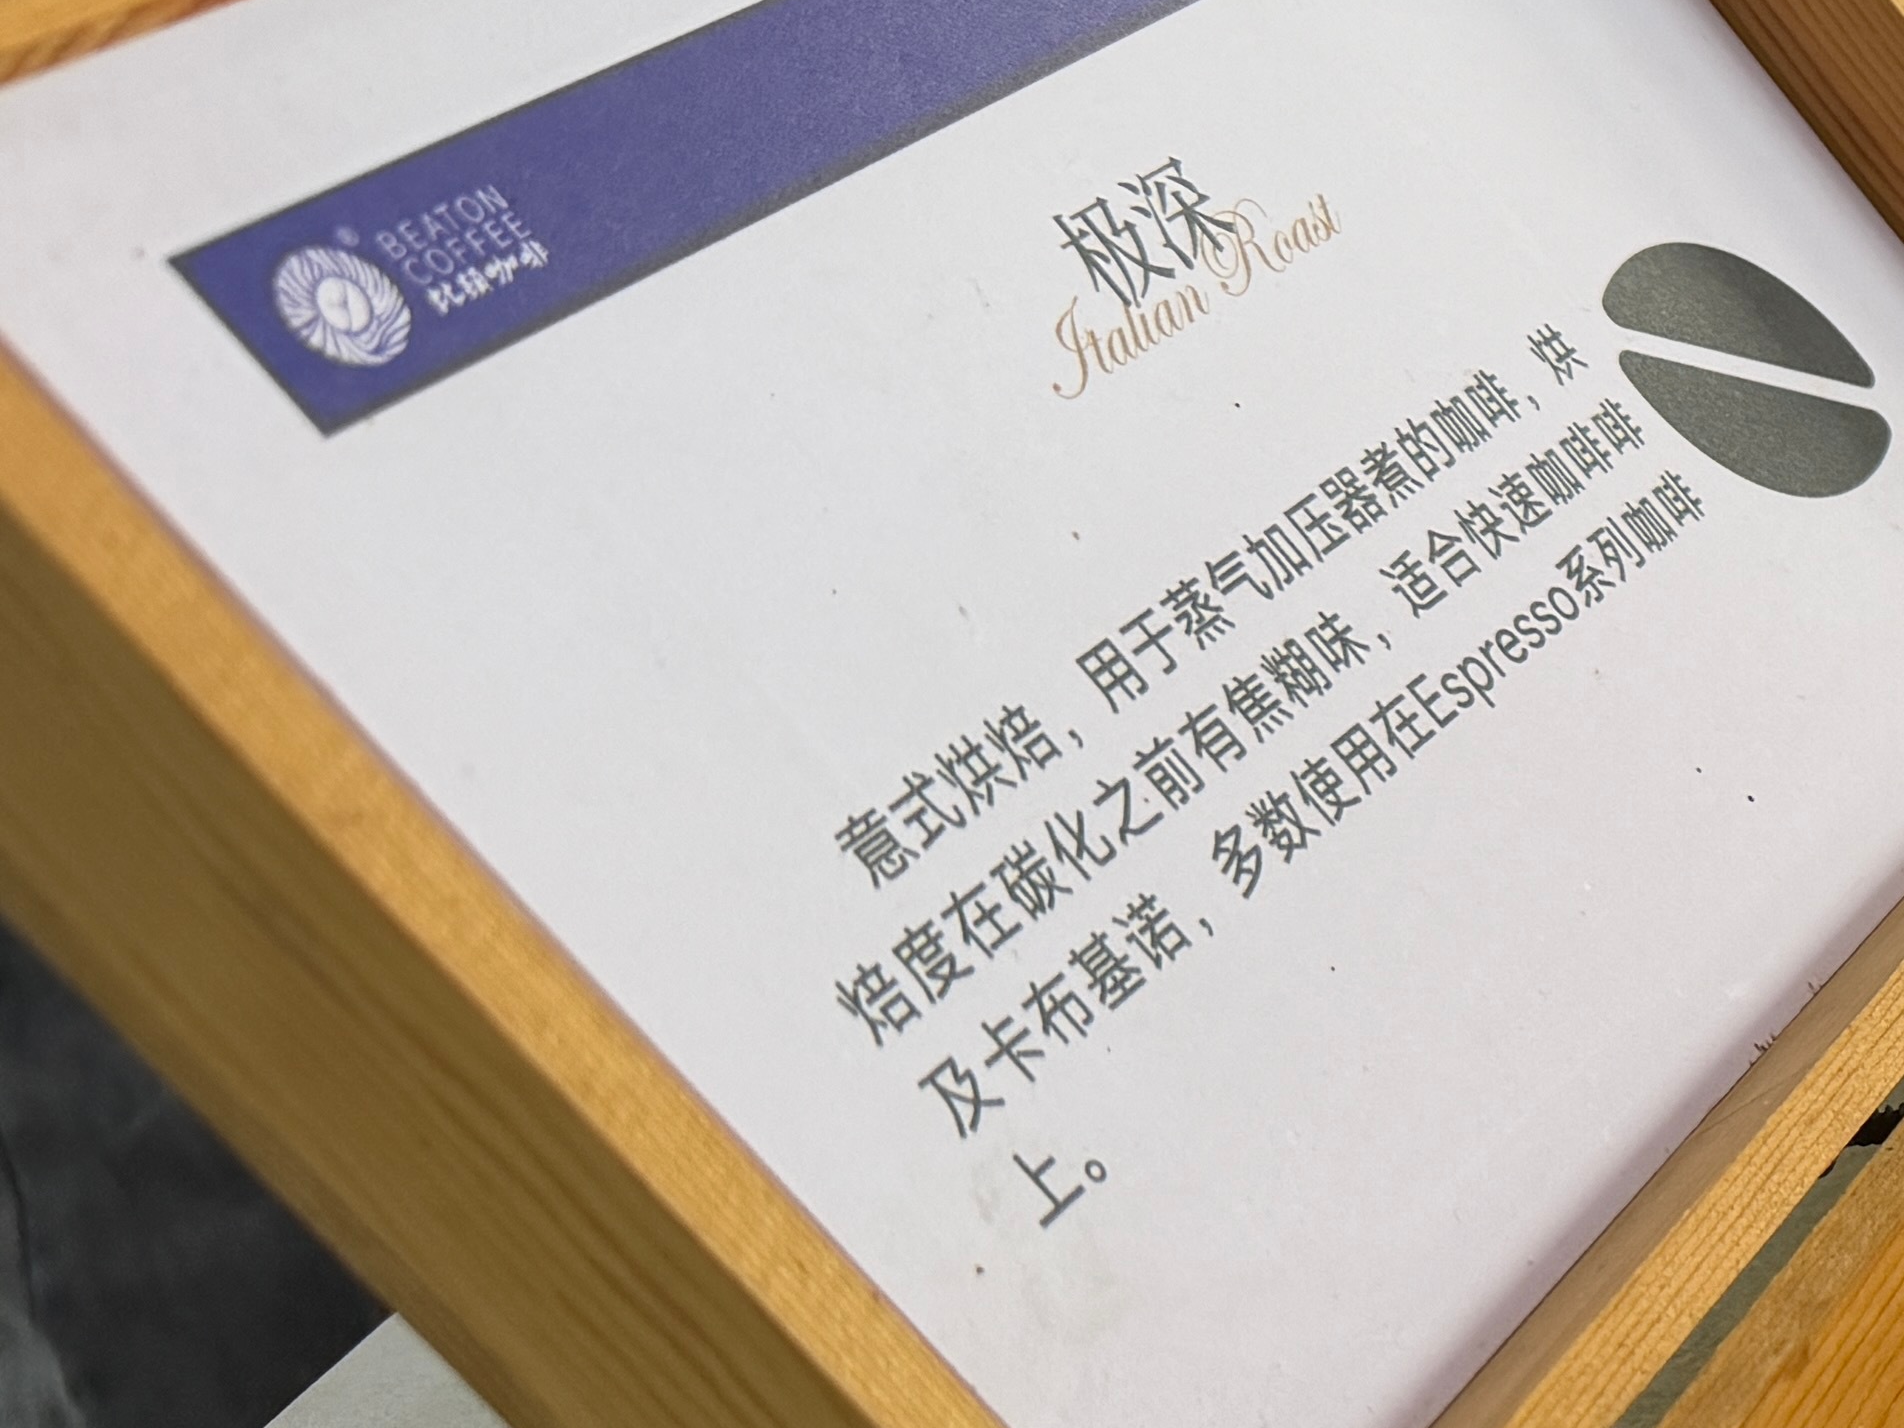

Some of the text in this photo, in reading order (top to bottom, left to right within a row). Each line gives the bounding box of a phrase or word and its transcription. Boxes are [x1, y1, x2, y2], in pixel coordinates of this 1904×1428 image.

[375, 183, 509, 261] BEATON
[404, 210, 533, 285] COFFEE
[1052, 155, 1237, 309] 极深
[1051, 192, 1342, 401] Italian Roast
